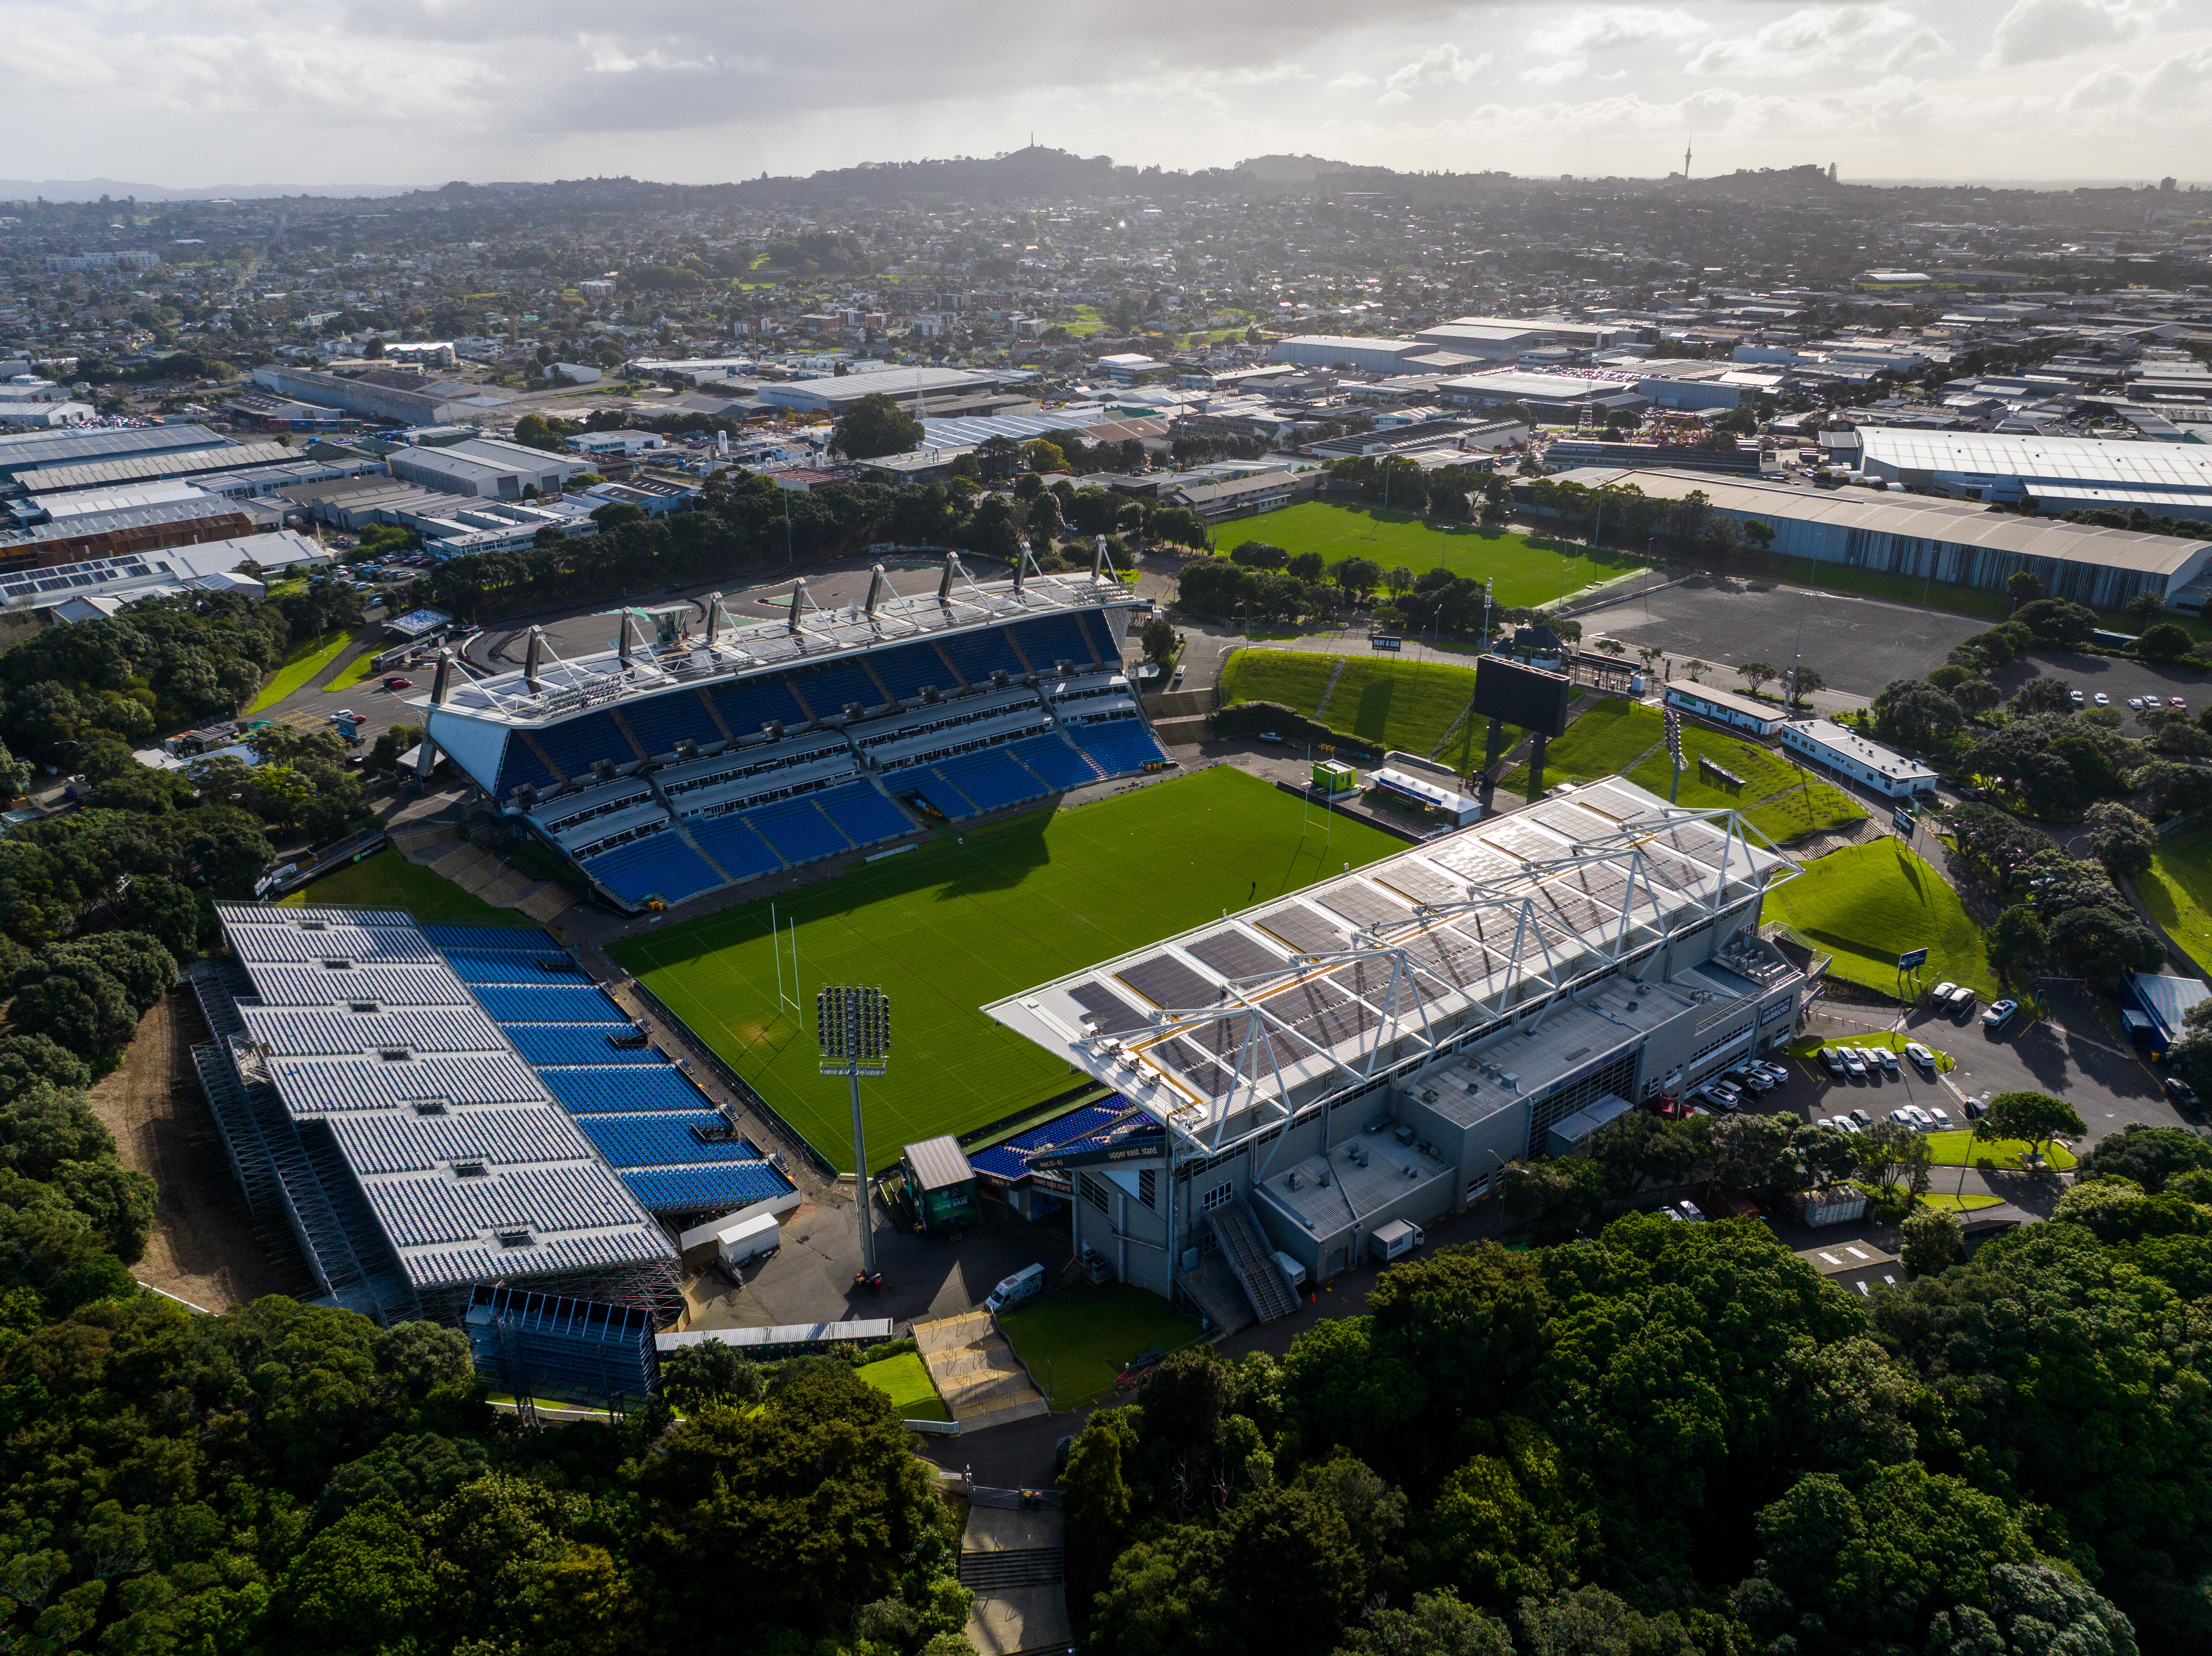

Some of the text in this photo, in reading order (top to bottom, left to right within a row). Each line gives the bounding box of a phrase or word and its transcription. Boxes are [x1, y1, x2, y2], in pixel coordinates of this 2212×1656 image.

[1777, 998, 1791, 1008] ZEALAND
[1762, 1004, 1790, 1025] WARRIORS
[1109, 1151, 1126, 1159] upper
[1142, 1146, 1158, 1154] stand
[1033, 1176, 1046, 1185] lower
[1057, 1181, 1071, 1192] stand
[934, 1199, 968, 1212] HOME BASE
